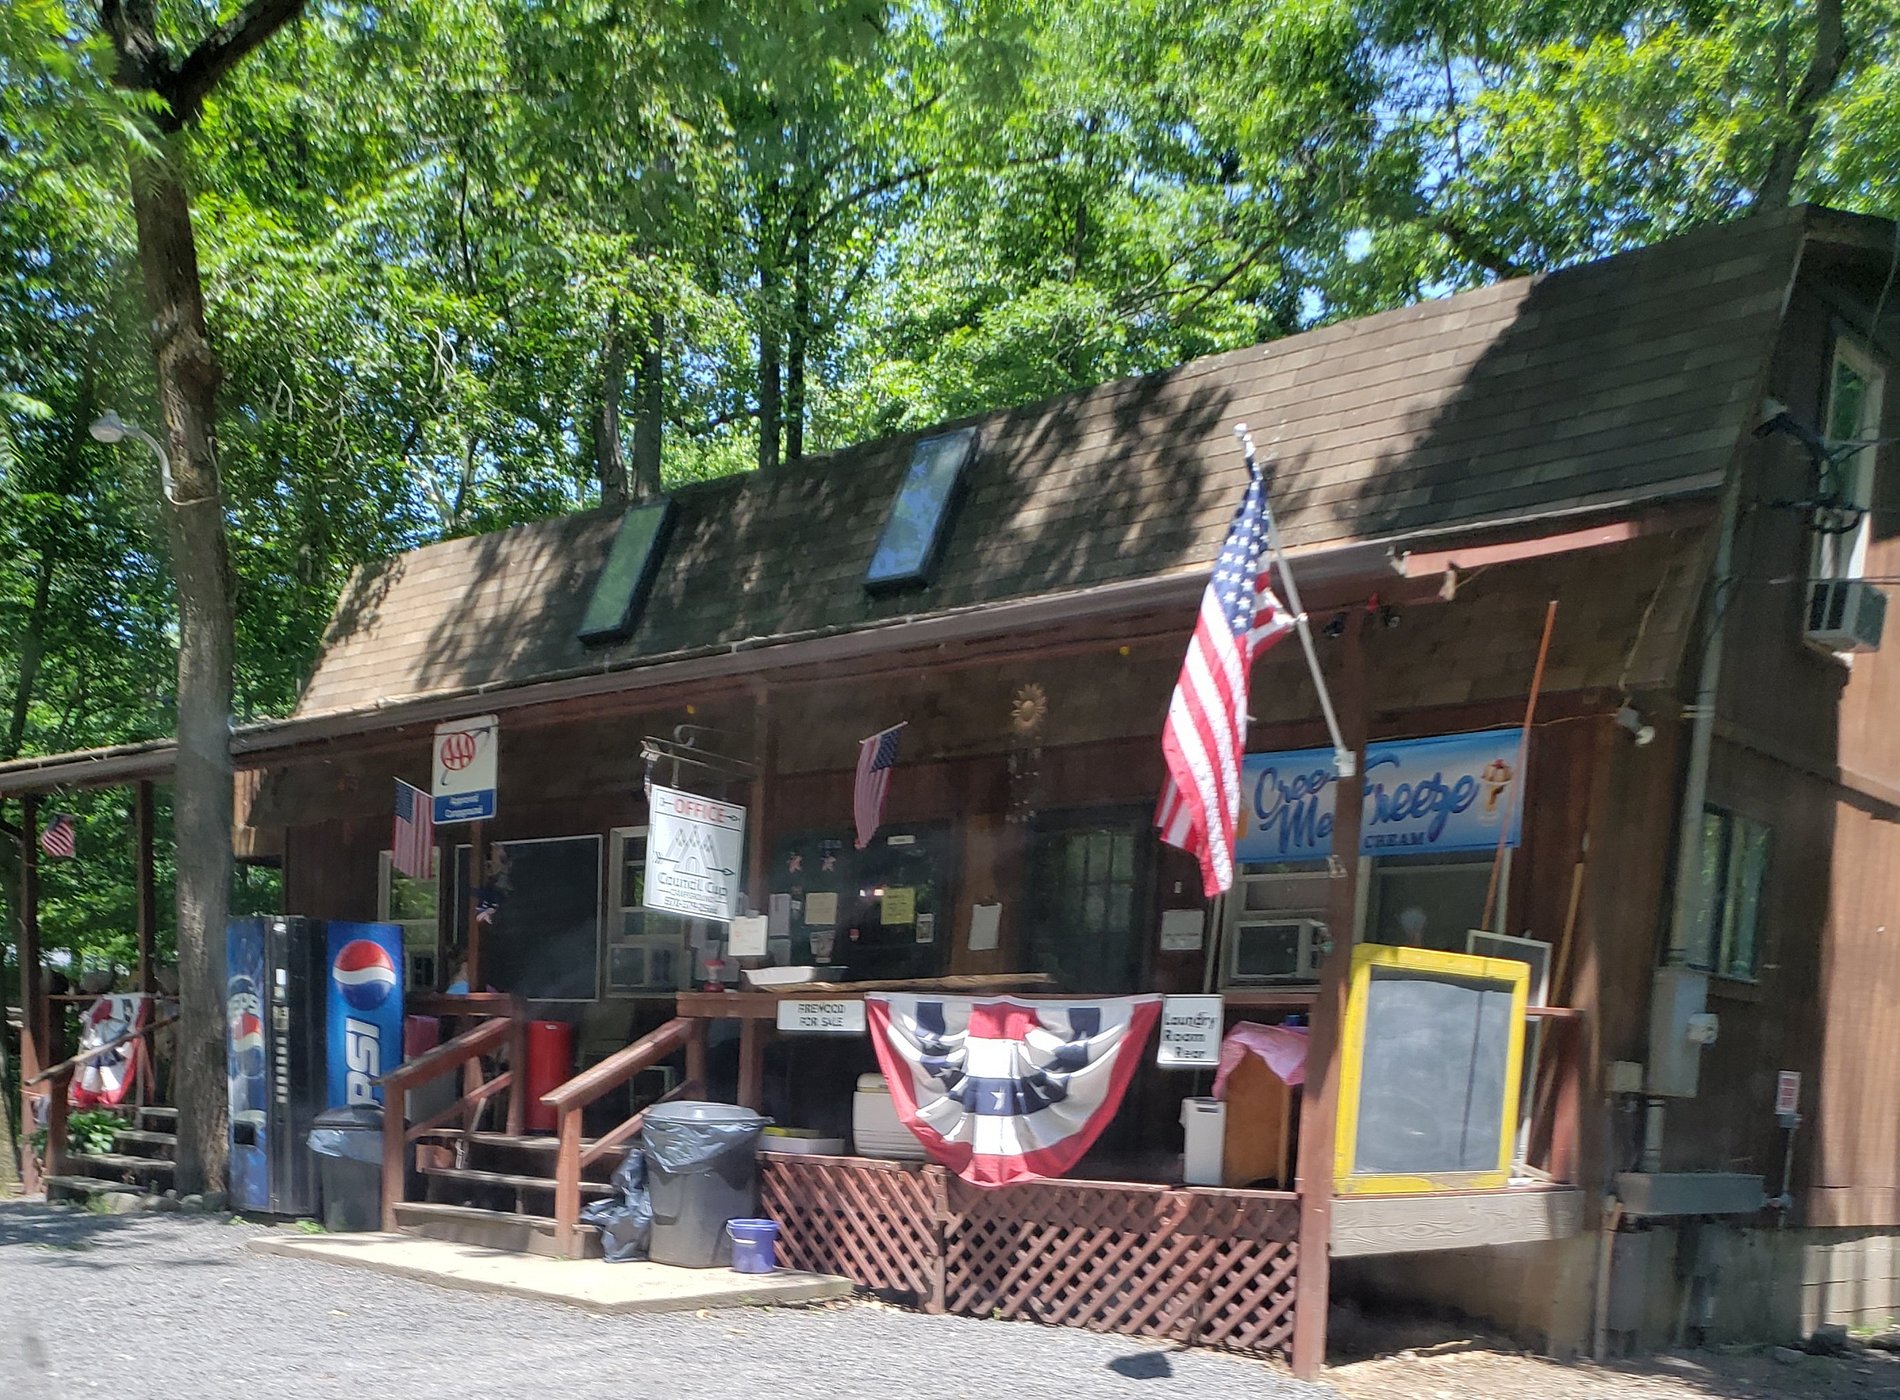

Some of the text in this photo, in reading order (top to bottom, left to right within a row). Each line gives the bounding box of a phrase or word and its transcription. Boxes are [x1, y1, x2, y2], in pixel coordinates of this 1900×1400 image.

[443, 735, 473, 768] AAA
[674, 799, 725, 823] OFFICE
[1364, 832, 1424, 848] CREAM
[658, 872, 703, 892] Council
[705, 881, 728, 898] Cup
[800, 1017, 844, 1027] FOR SALE
[1164, 1011, 1216, 1030] Laundry
[1164, 1029, 1205, 1042] Room
[1174, 1045, 1206, 1058] Rear
